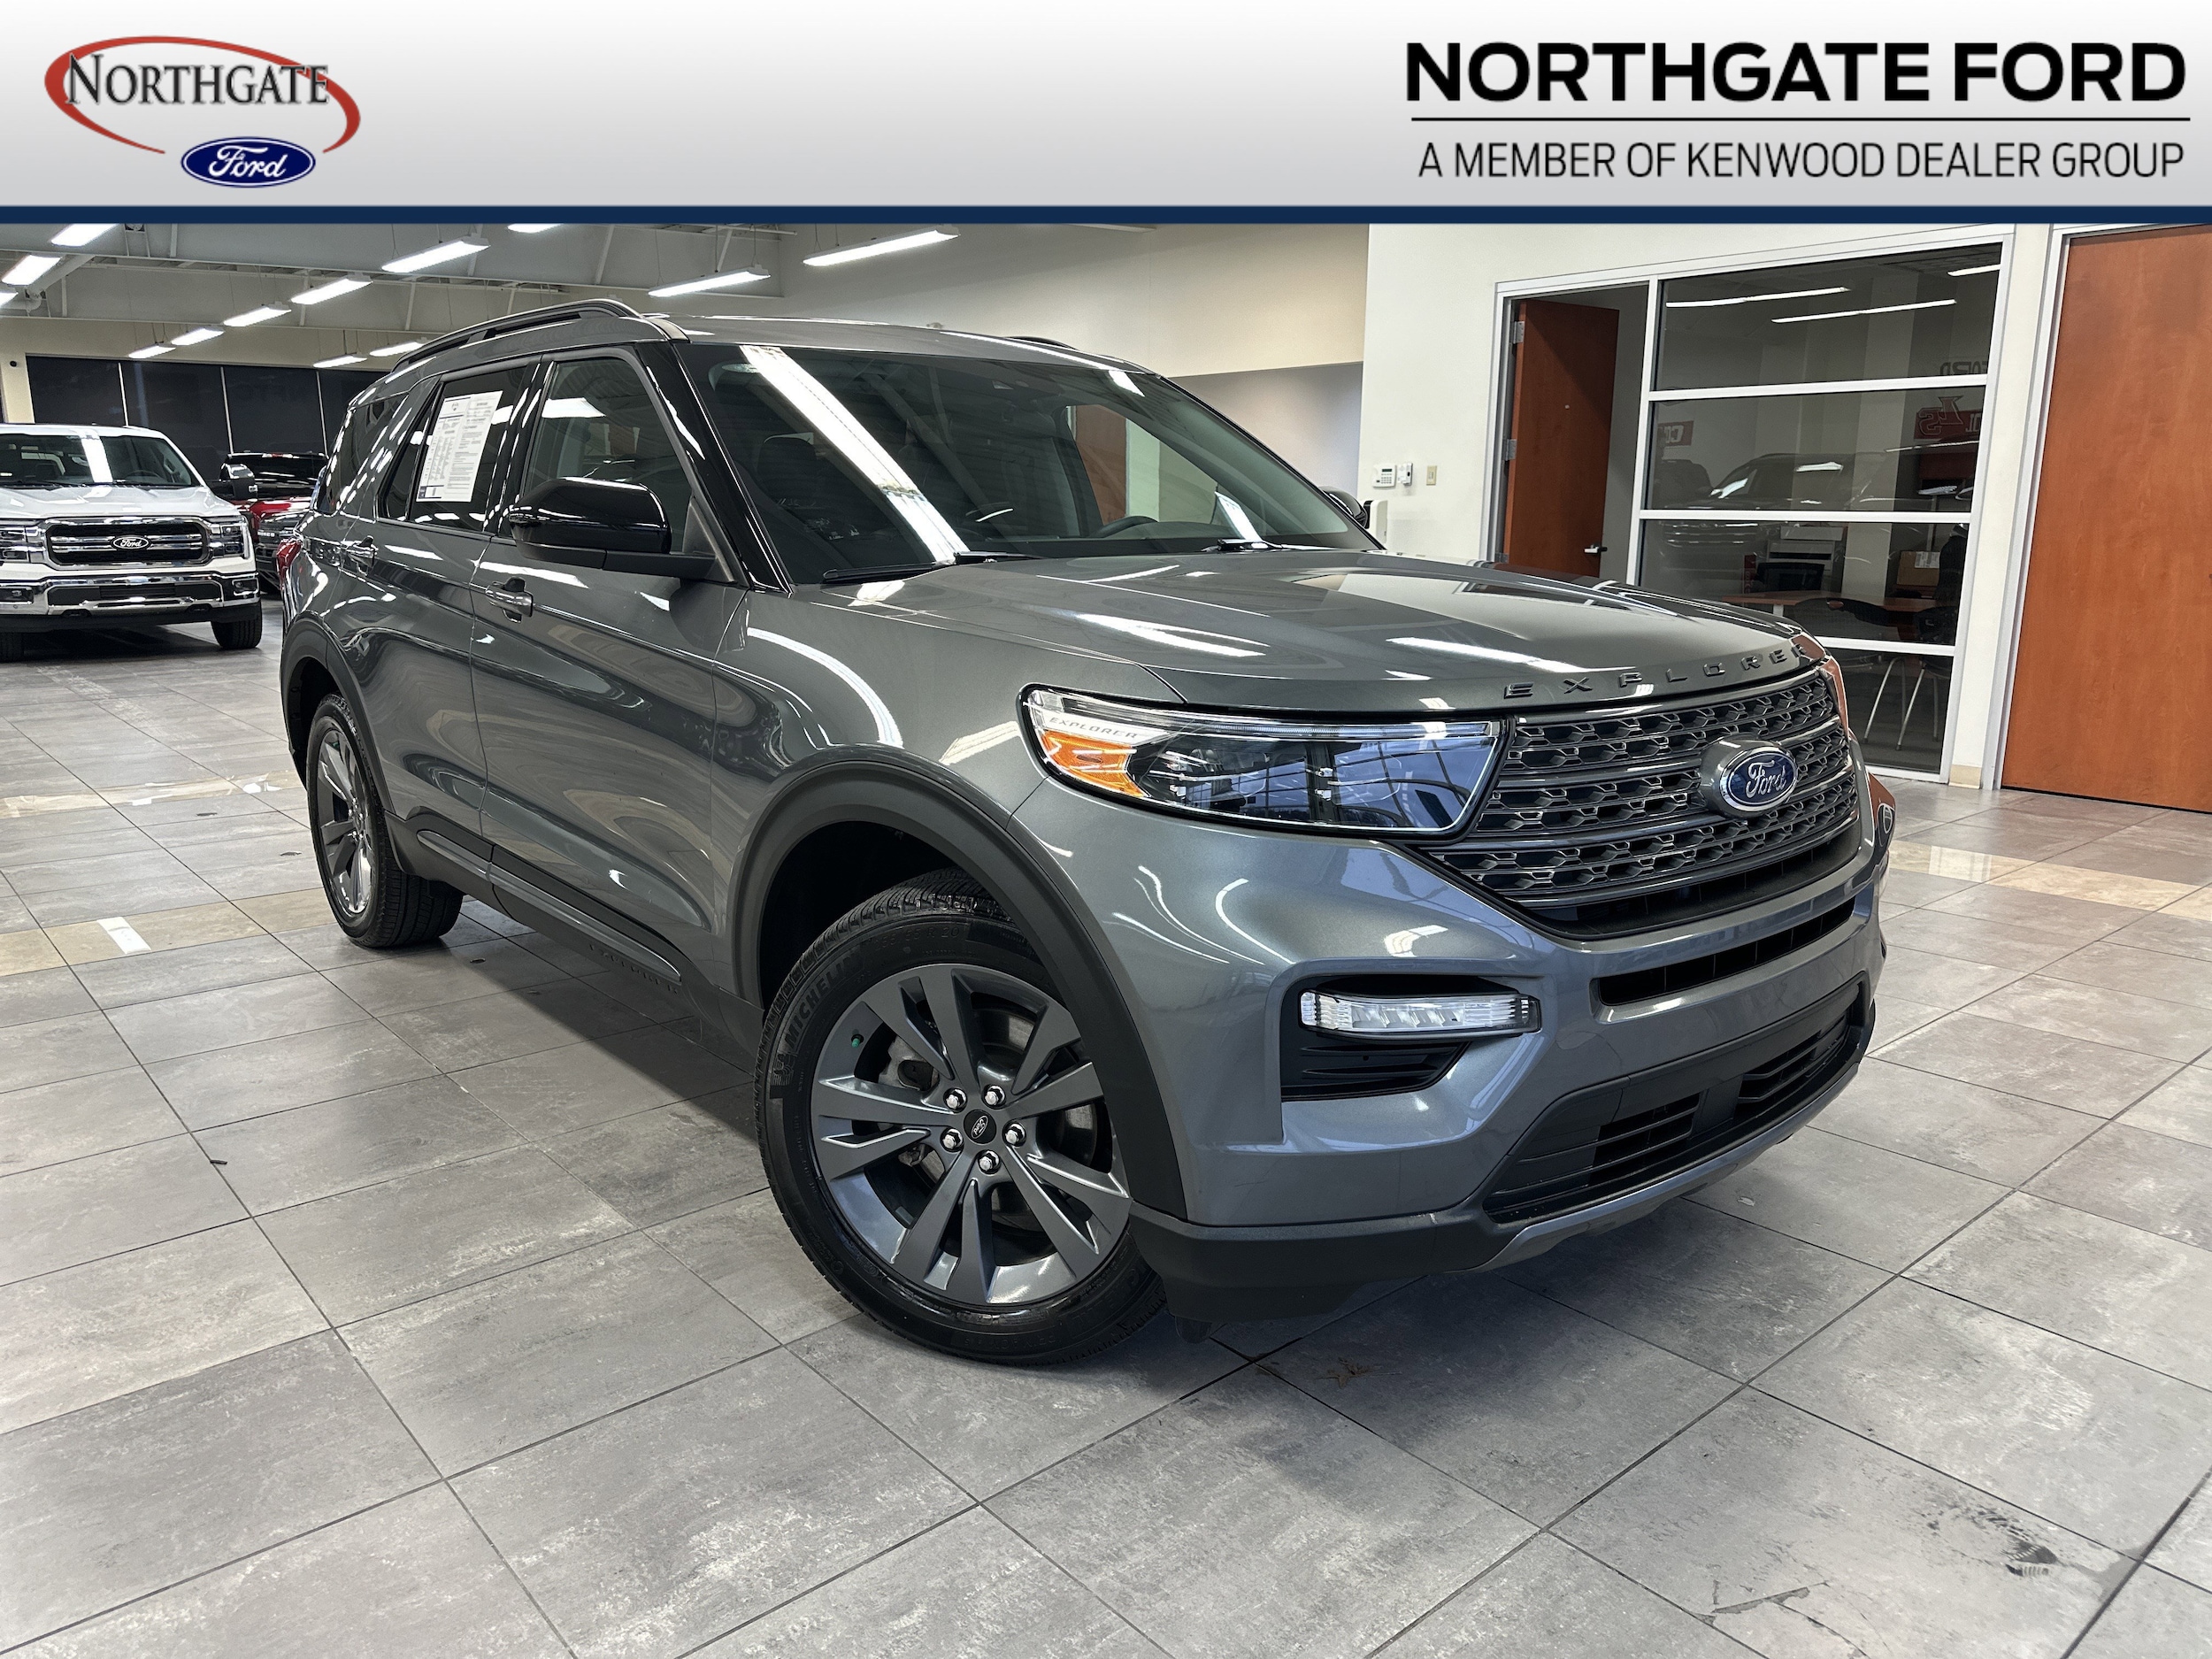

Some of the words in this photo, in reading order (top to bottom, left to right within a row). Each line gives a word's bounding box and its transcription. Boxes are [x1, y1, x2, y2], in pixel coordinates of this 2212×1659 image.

[120, 538, 142, 547] Ford
[1504, 643, 1808, 698] EXPLORER
[1049, 718, 1138, 738] EXPLORER
[1746, 760, 1786, 798] Ford
[785, 950, 861, 1049] MICHELIN
[973, 1118, 986, 1135] Ford
